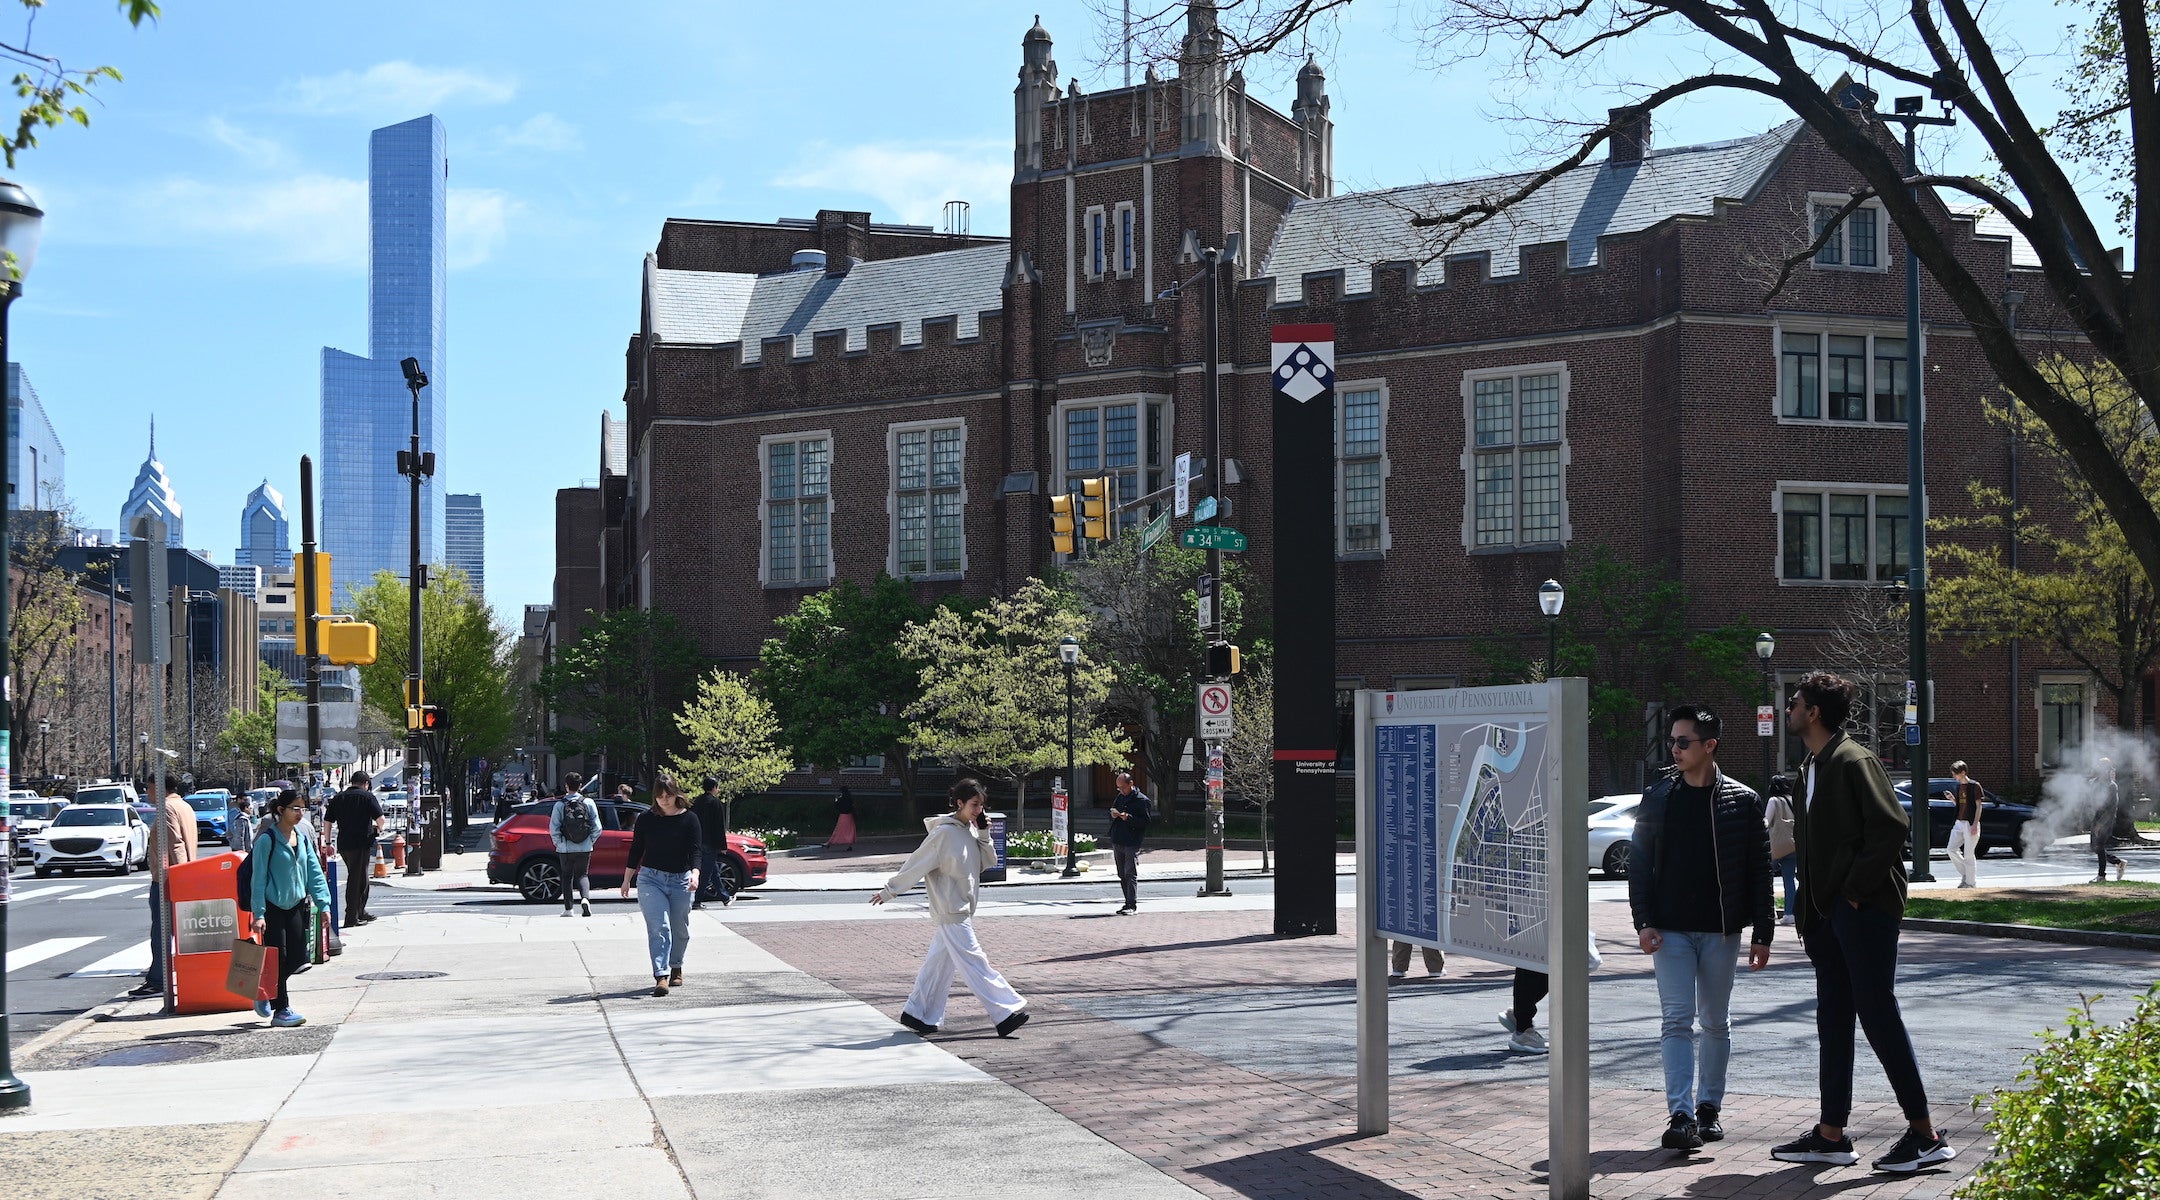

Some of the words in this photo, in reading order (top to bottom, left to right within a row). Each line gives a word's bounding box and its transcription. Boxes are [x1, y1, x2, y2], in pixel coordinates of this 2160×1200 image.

[1178, 460, 1187, 474] NO
[1234, 539, 1243, 547] ST
[1396, 694, 1446, 711] UNIVERSITY
[1448, 690, 1460, 712] of
[1462, 690, 1534, 708] PENNSYLVANIA
[1216, 719, 1229, 727] USE
[1202, 727, 1231, 735] CROSSWALK
